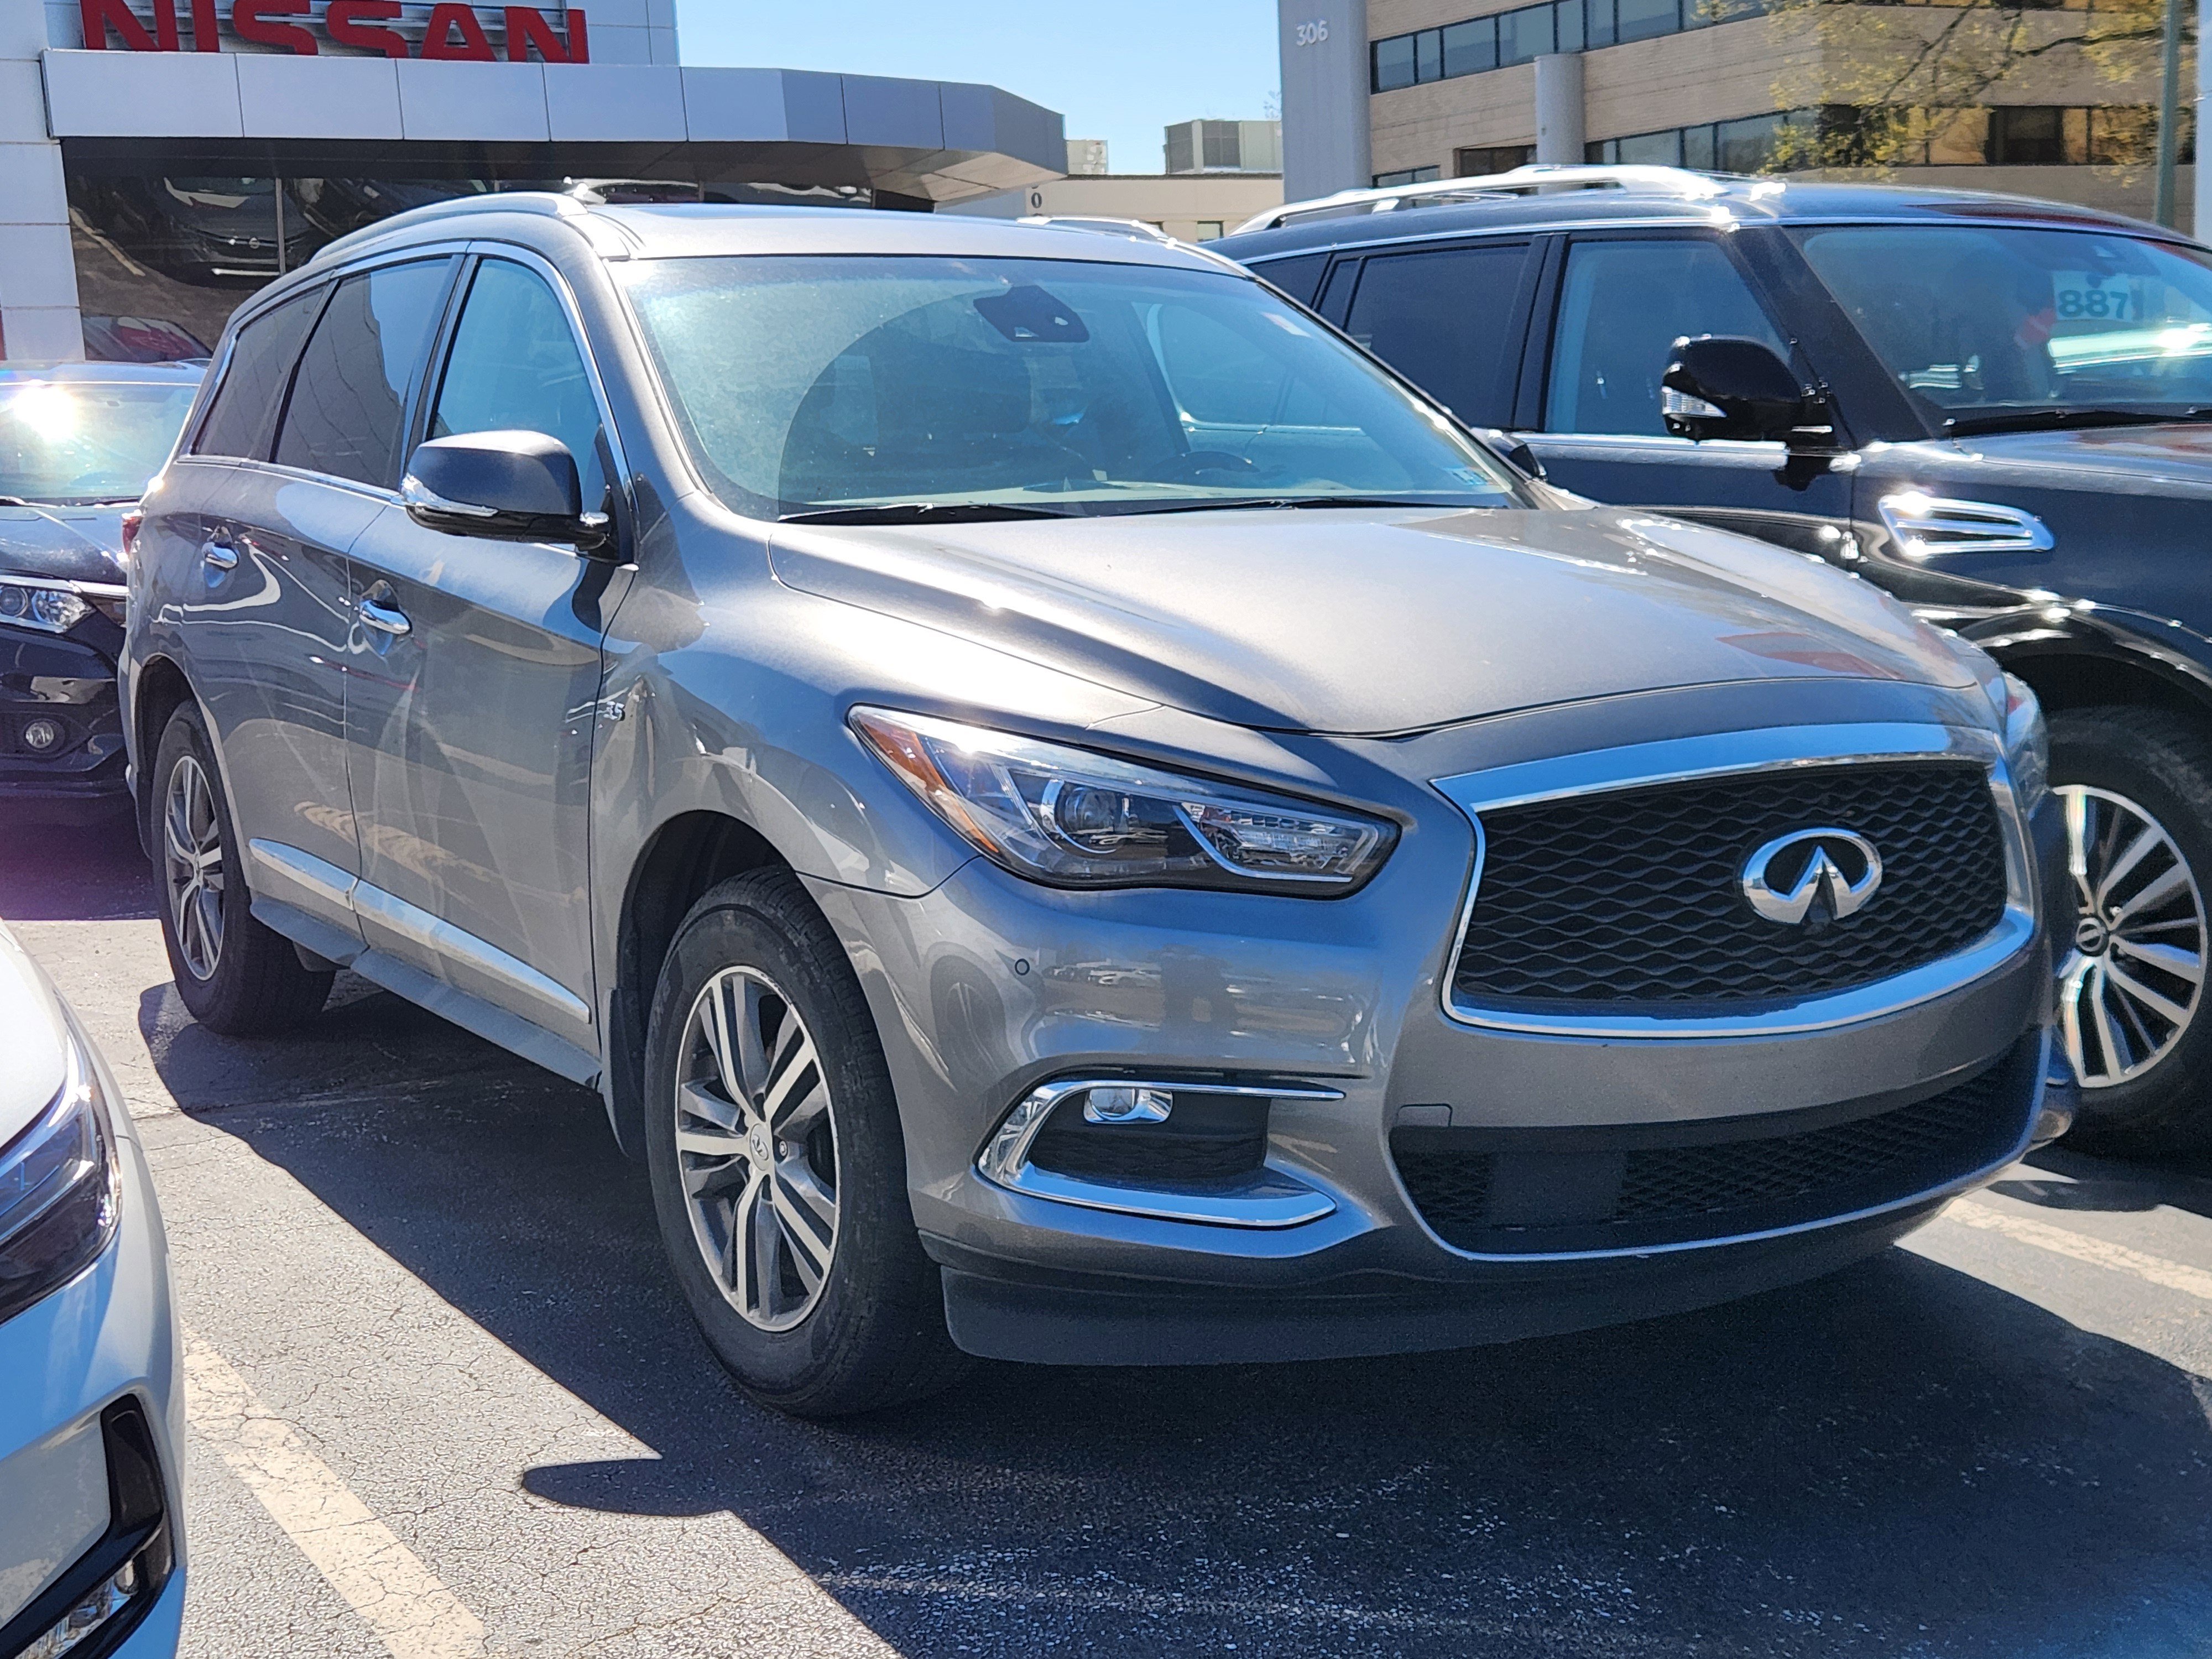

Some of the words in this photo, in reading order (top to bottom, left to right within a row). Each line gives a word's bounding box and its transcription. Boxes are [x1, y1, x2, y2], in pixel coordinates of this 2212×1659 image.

[80, 0, 589, 64] NISSAN
[1296, 19, 1328, 46] 306
[2058, 289, 2128, 319] 887
